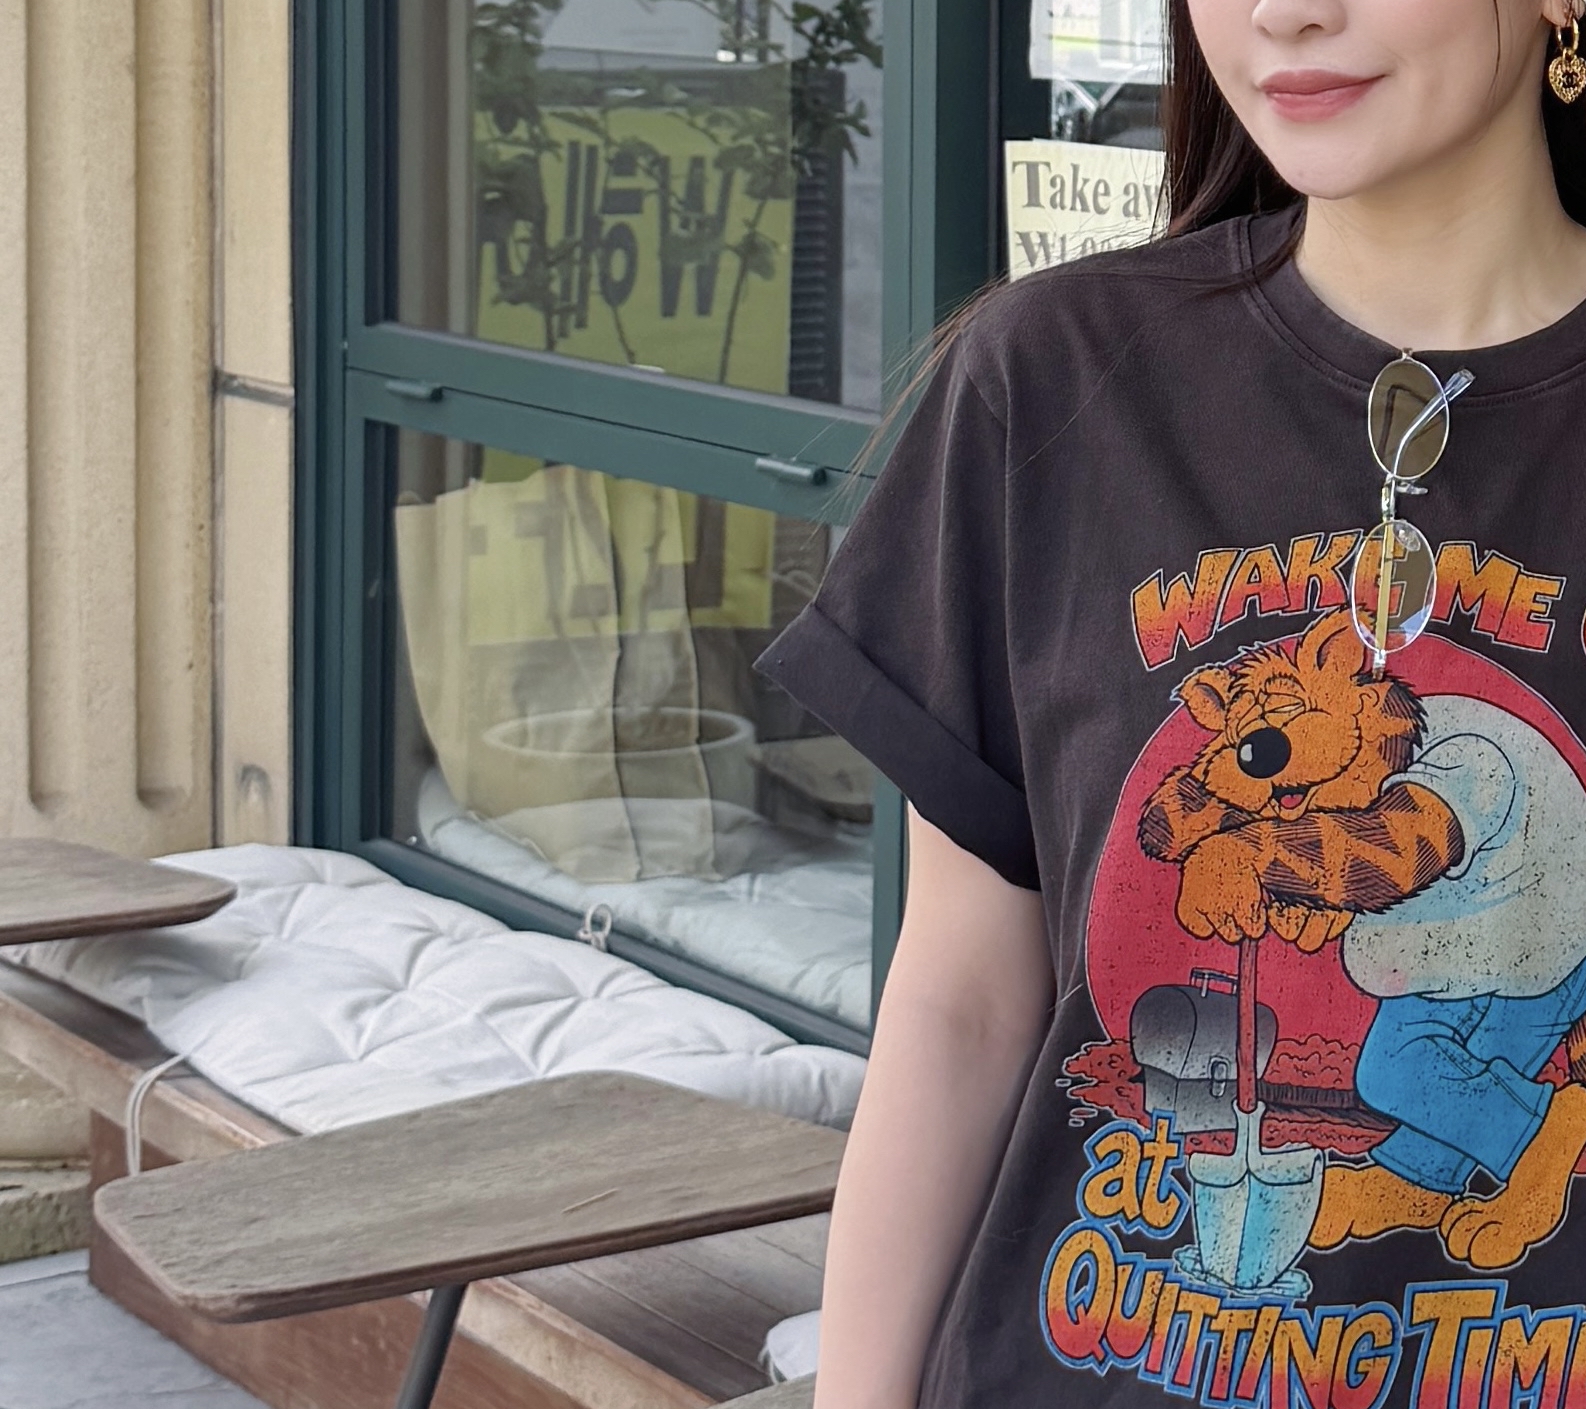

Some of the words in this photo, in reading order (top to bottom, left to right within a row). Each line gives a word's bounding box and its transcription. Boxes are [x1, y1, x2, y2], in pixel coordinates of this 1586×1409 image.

[1012, 160, 1112, 216] Take
[1130, 528, 1409, 671] WAKE
[1422, 540, 1567, 654] ME
[1080, 1110, 1192, 1239] at
